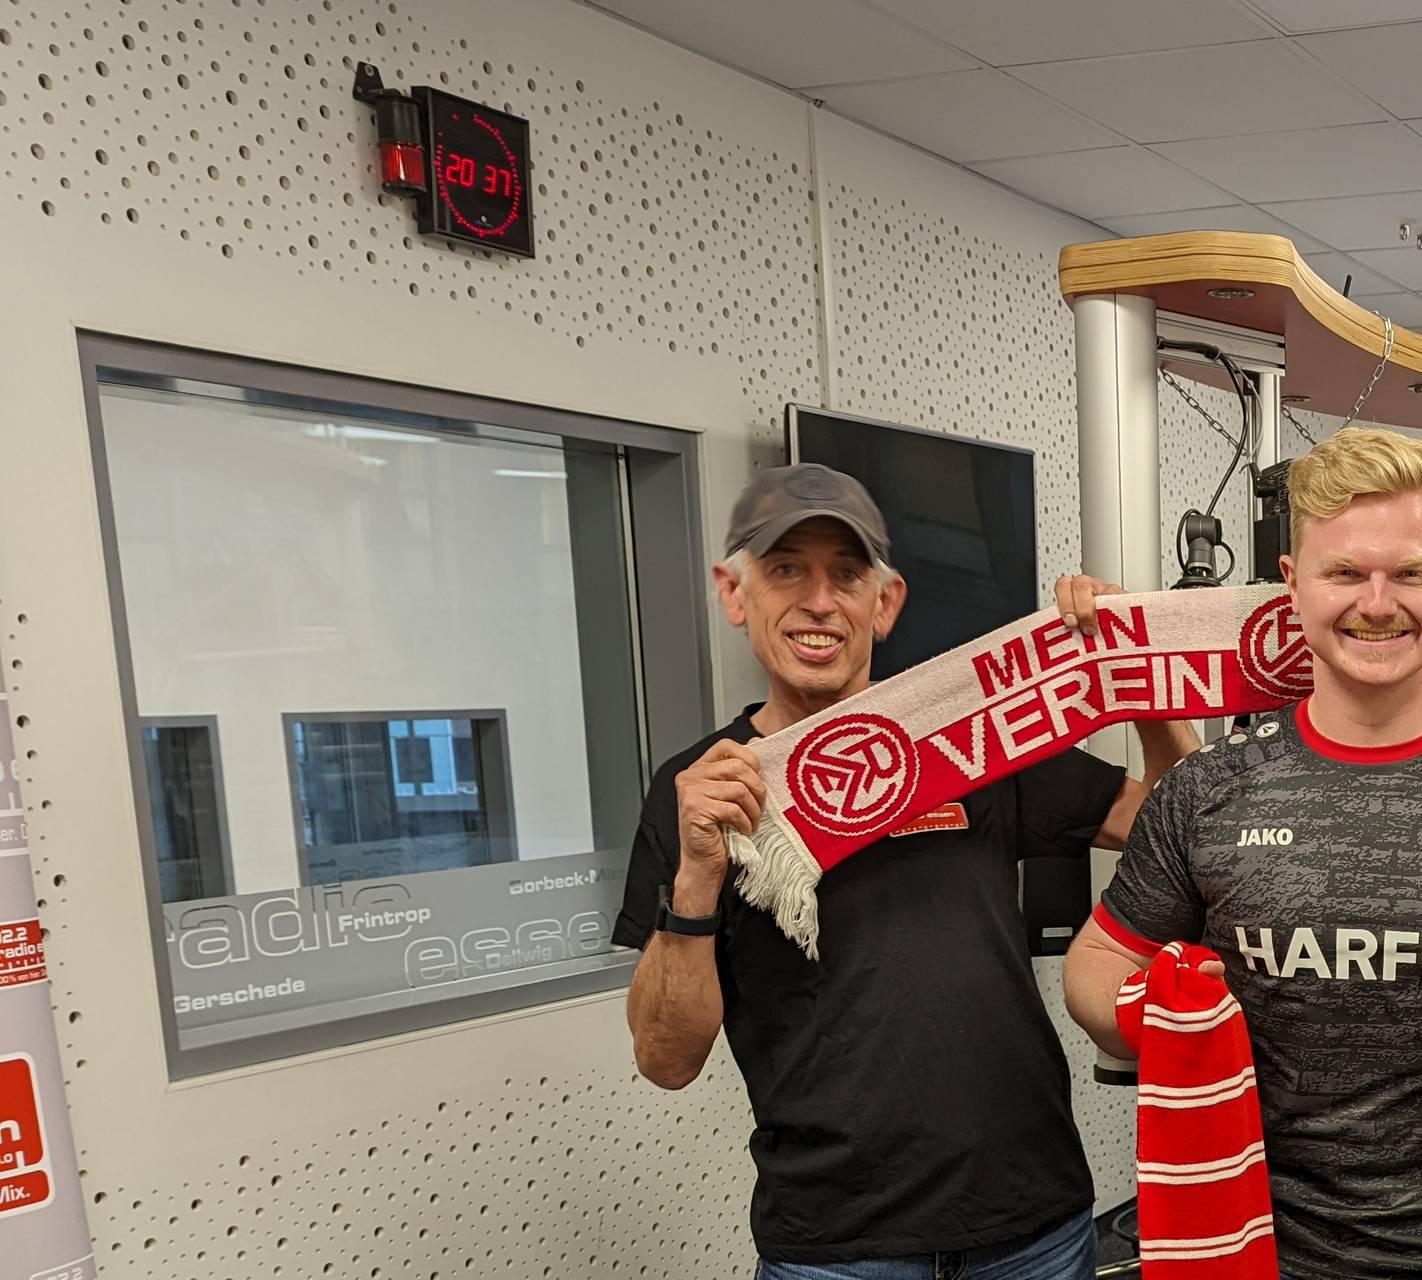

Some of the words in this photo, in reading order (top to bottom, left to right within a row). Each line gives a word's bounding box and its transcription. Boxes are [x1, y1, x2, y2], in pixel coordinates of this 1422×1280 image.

[446, 153, 475, 188] 20
[483, 164, 511, 197] 37
[927, 653, 1224, 782] VEREIN
[1237, 828, 1293, 847] JAKO
[164, 862, 412, 969] adio
[338, 907, 431, 932] Frintrop
[0, 926, 28, 944] 2.2
[405, 911, 612, 988] esse
[486, 944, 552, 969] Dellwig
[174, 978, 306, 1013] Gerschede
